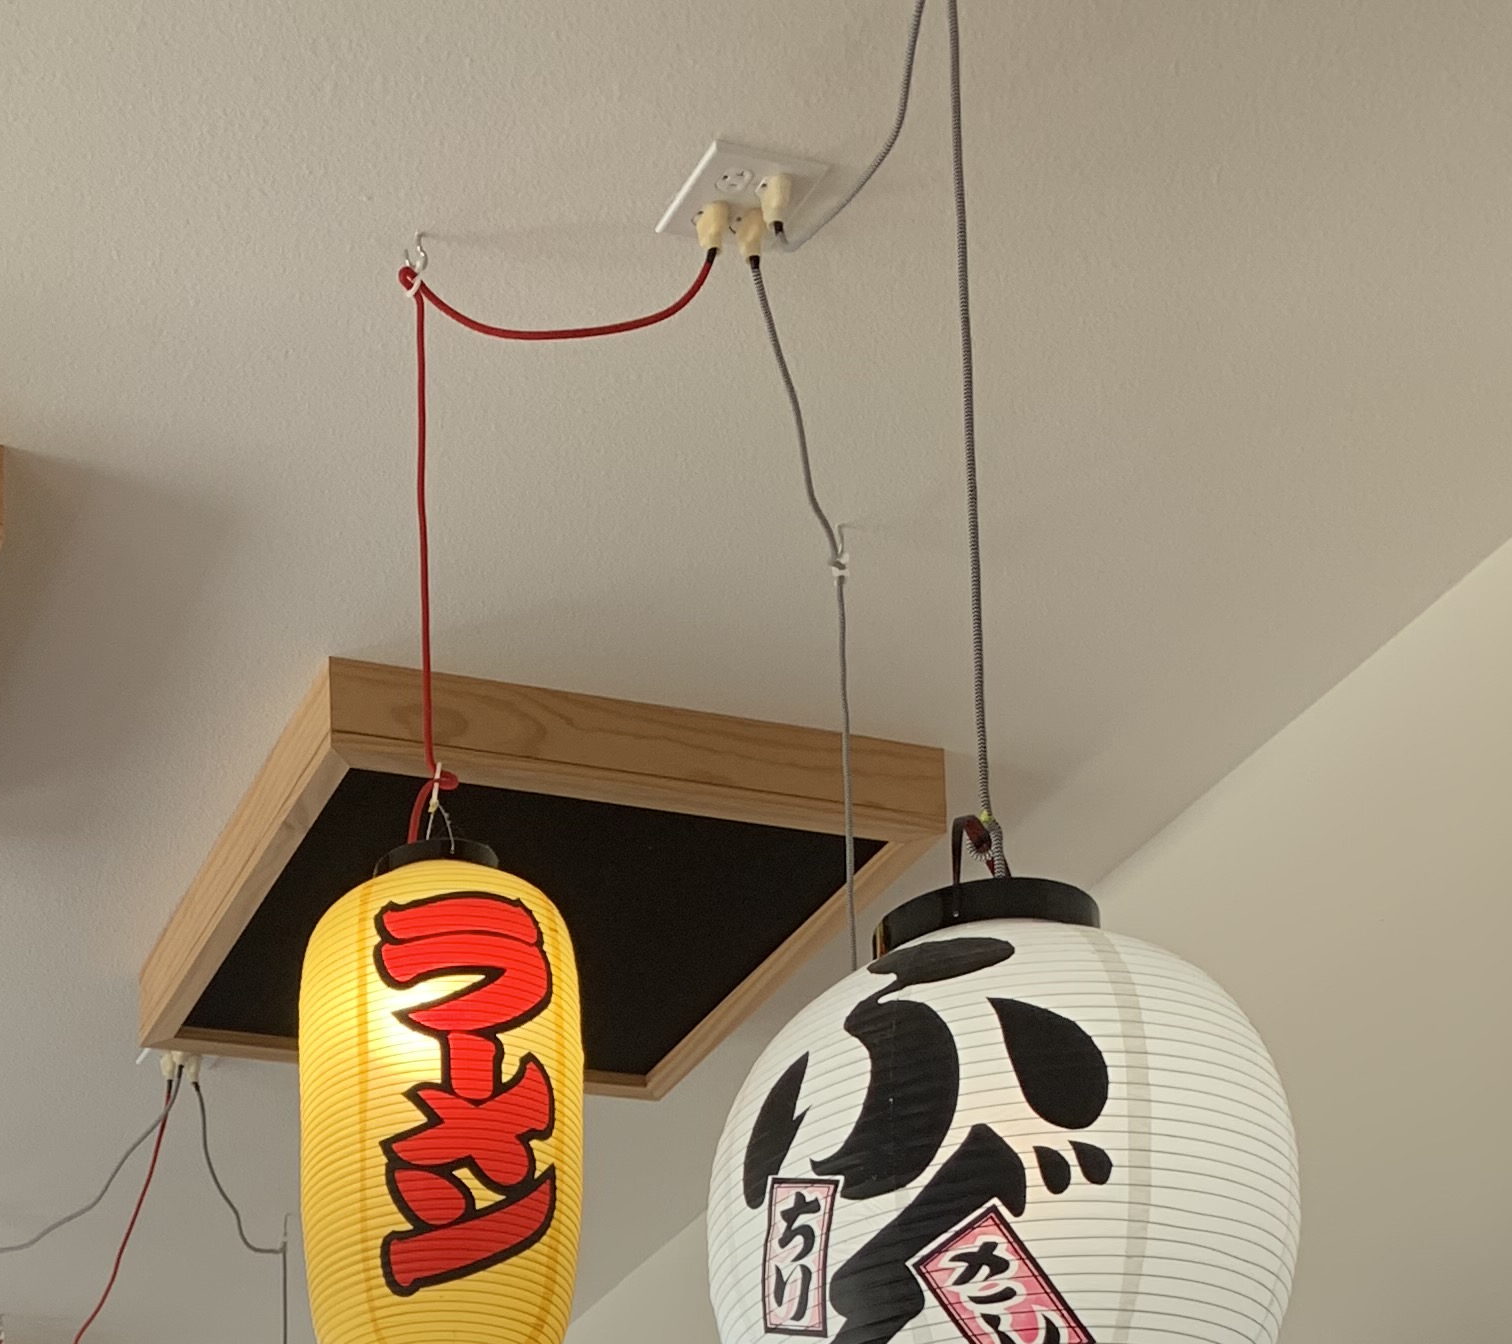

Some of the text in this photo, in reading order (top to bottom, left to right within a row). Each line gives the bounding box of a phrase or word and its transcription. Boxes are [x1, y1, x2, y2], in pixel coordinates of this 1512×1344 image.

[373, 890, 554, 1296] ラーメン
[774, 1191, 821, 1322] ちり
